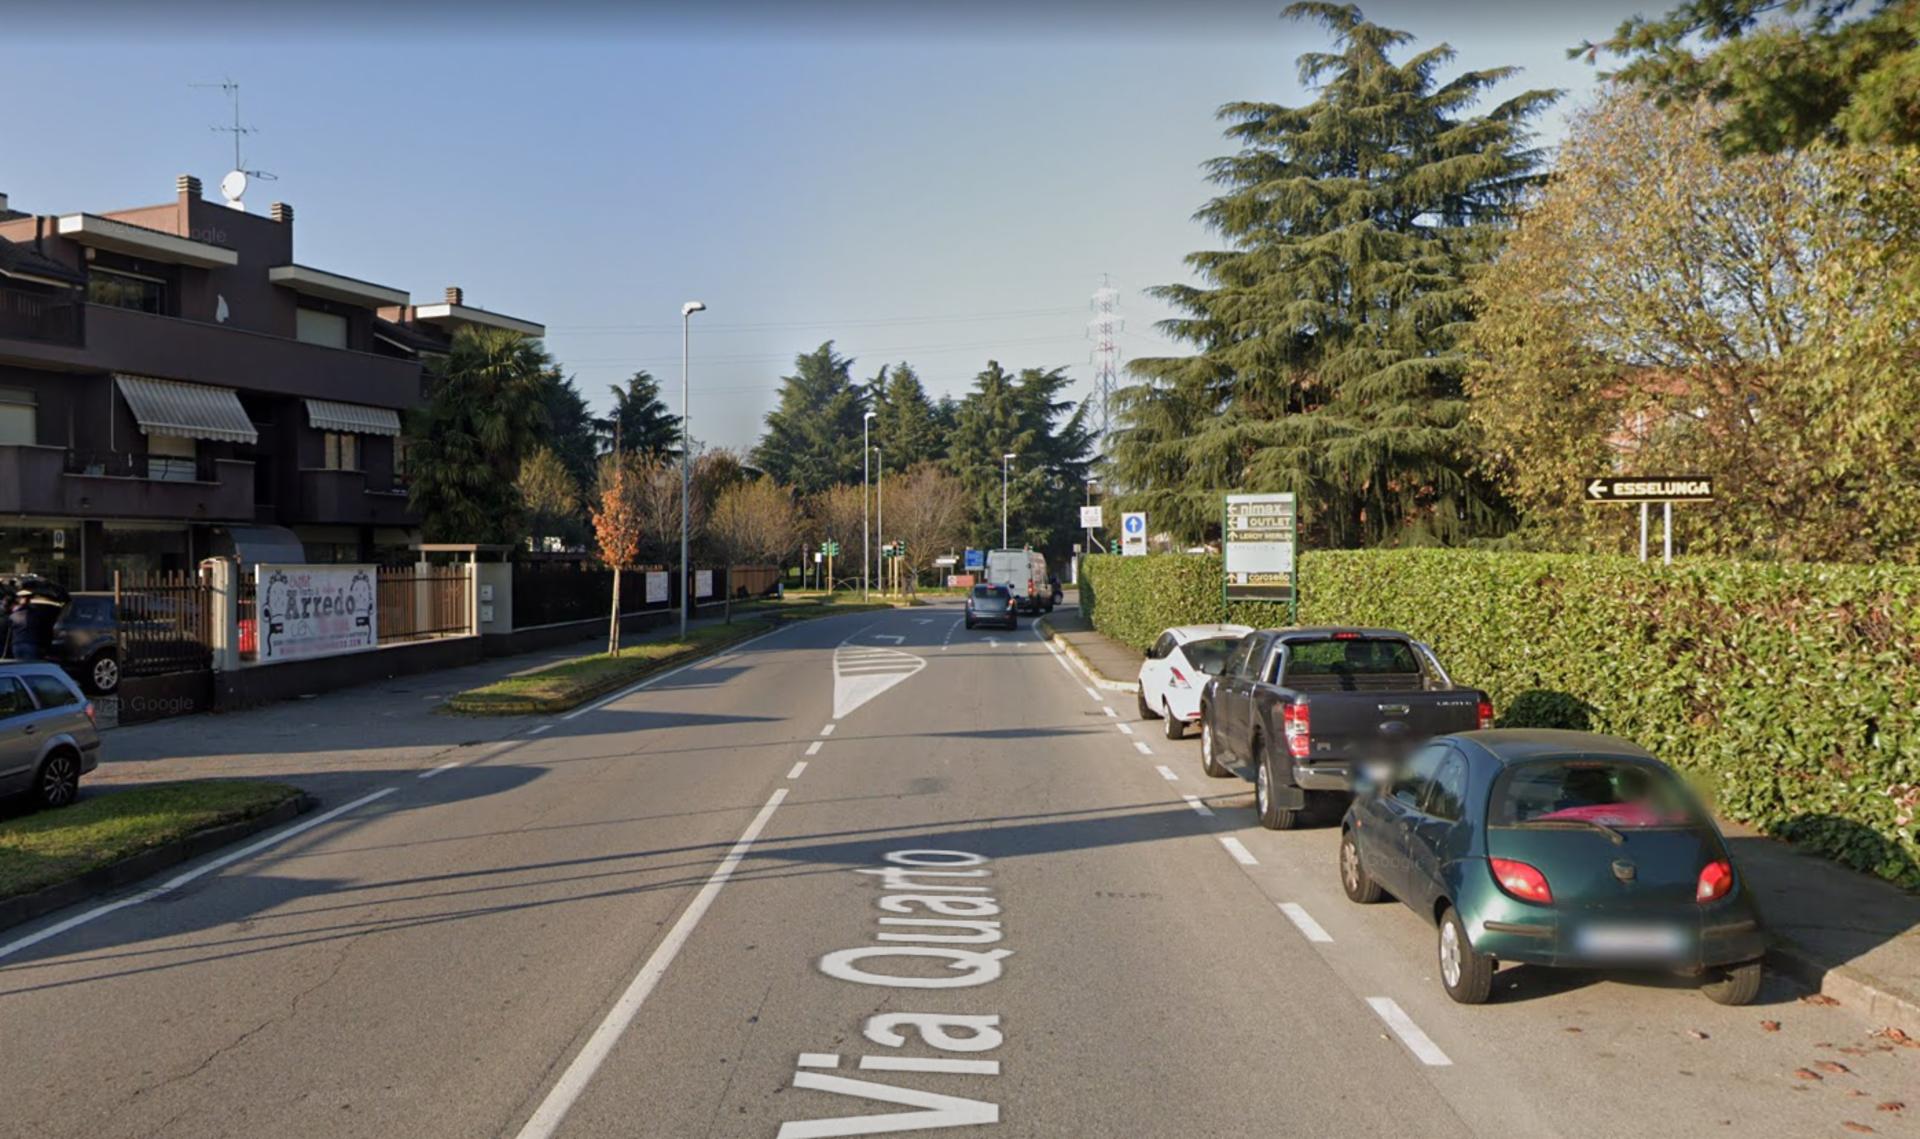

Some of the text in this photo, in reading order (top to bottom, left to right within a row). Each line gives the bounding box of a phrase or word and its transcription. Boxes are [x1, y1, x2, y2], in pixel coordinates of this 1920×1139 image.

[1613, 481, 1710, 496] ESSELUNGA
[1250, 517, 1291, 526] OUTLET
[285, 588, 356, 621] Arredo
[776, 849, 1016, 1139] Via Quarto
